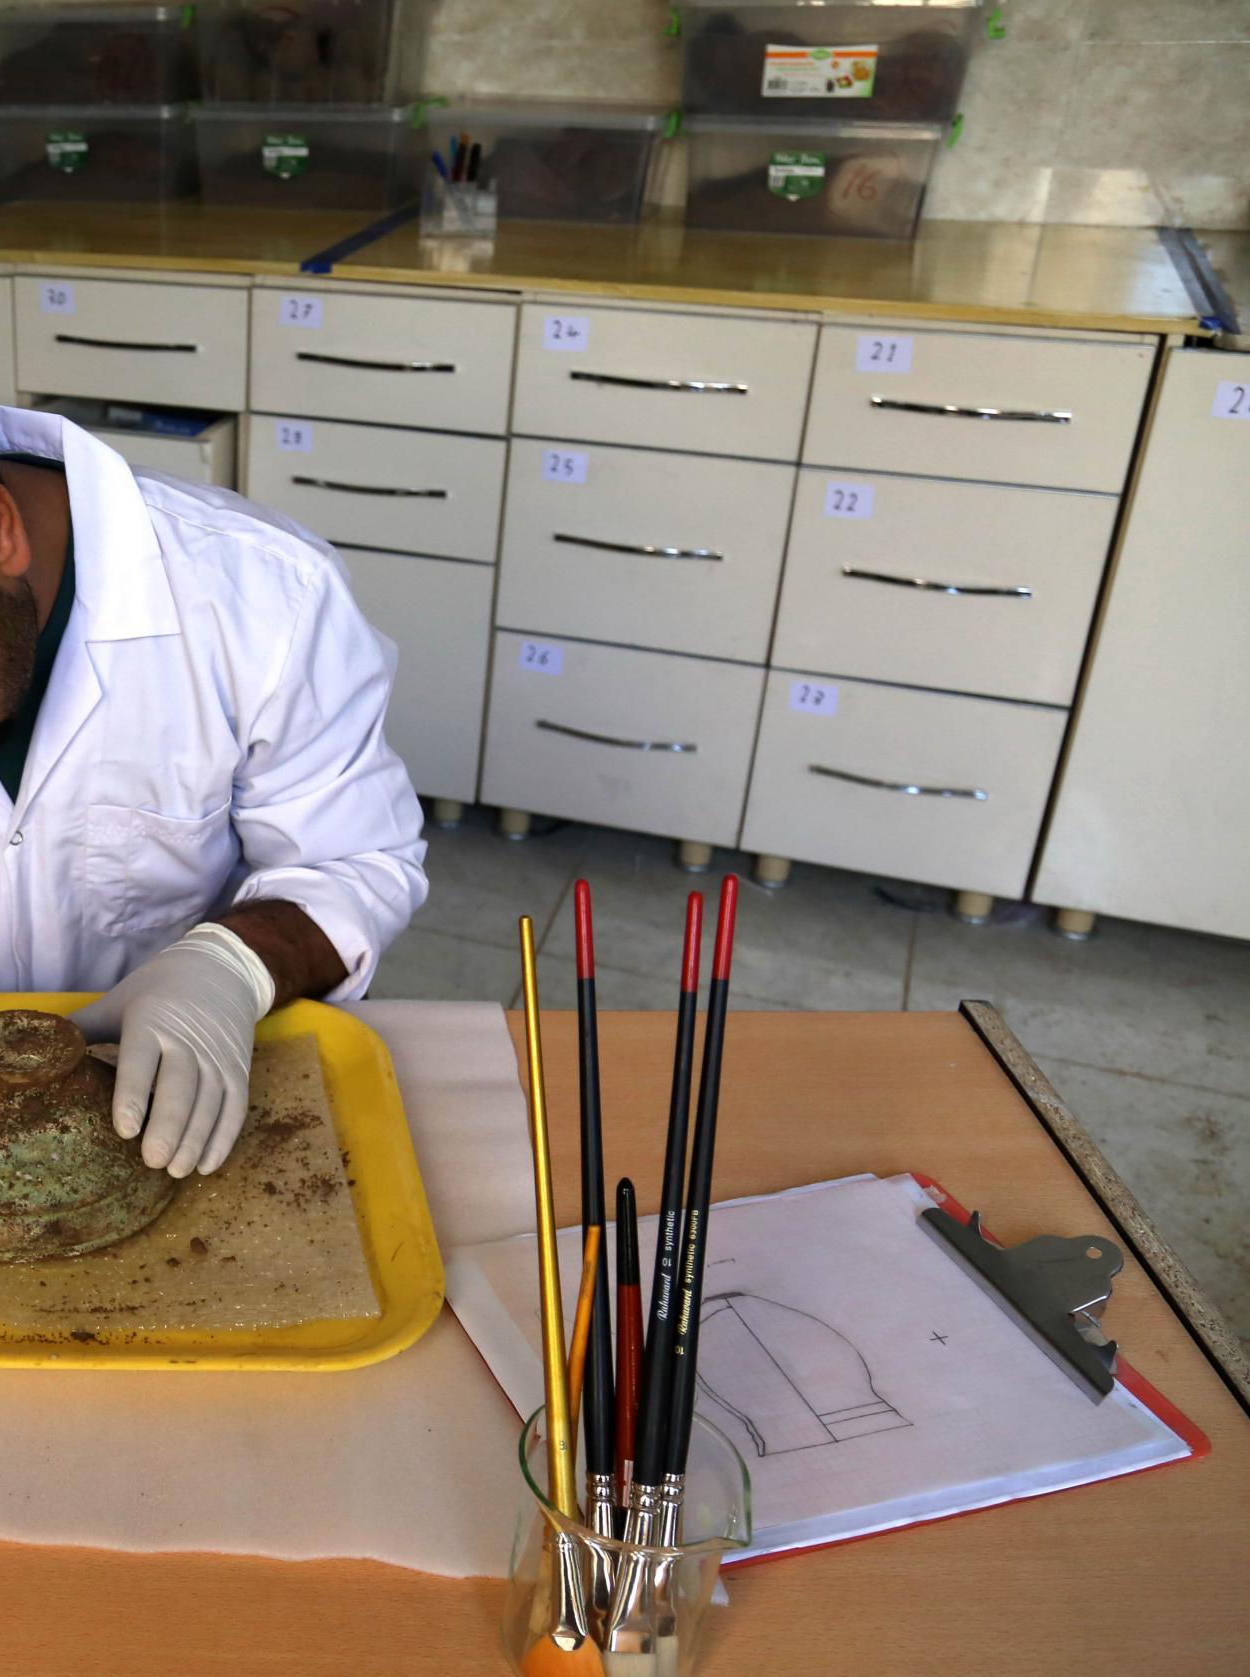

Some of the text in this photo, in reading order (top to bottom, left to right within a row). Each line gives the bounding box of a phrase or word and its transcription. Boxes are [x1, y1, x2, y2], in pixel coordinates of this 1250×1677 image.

[841, 164, 879, 201] 16
[551, 318, 581, 340] 24
[870, 340, 897, 363] 21
[1228, 385, 1250, 415] 2
[549, 452, 574, 477] 25
[831, 488, 859, 513] 22
[525, 643, 550, 667] 26
[657, 1210, 677, 1321] Rahavard 10 synthetic
[684, 1243, 697, 1284] synthetic
[678, 1288, 693, 1335] Rahavard
[675, 1345, 685, 1355] 10
